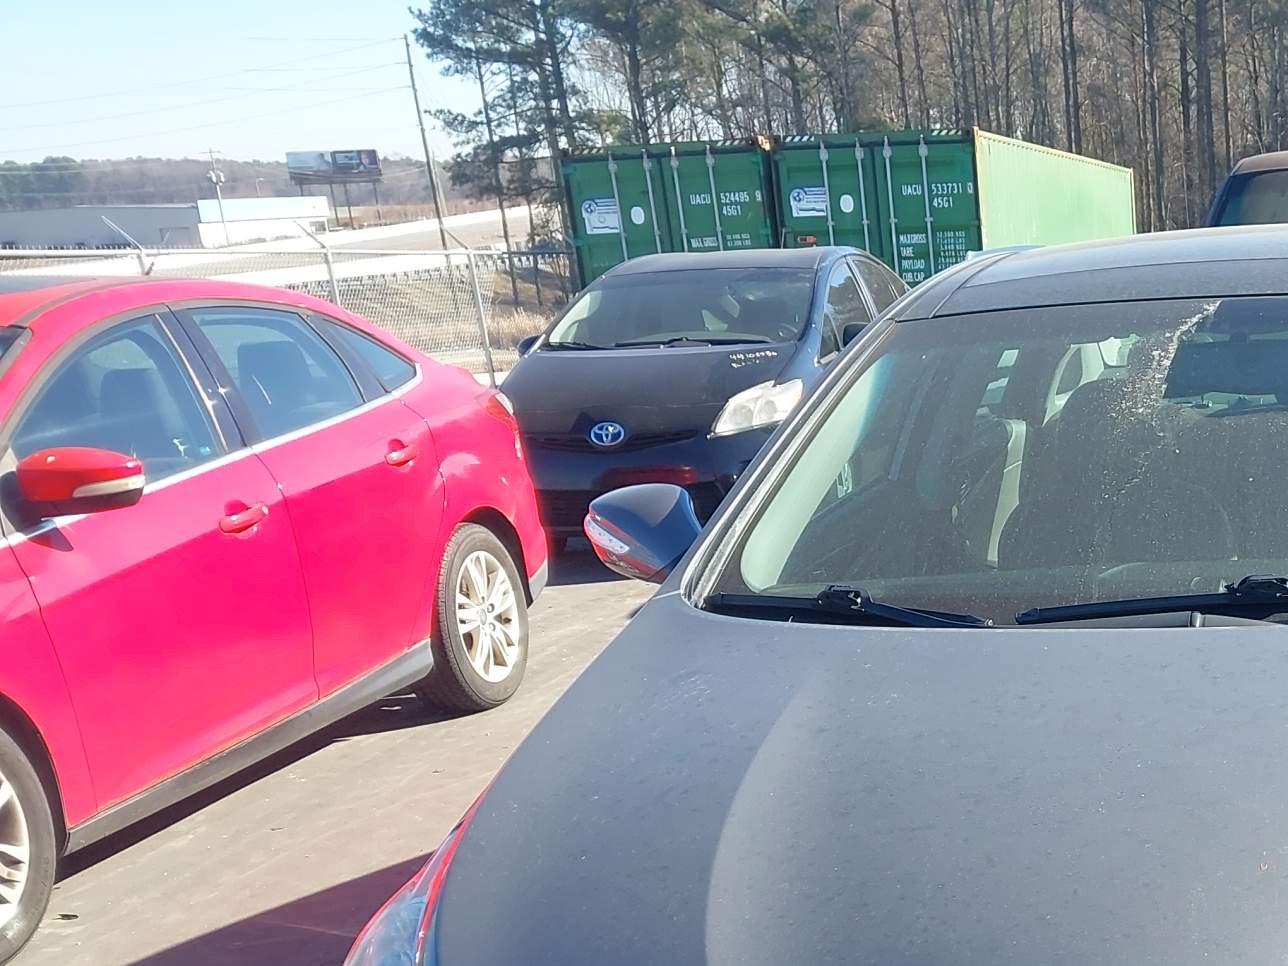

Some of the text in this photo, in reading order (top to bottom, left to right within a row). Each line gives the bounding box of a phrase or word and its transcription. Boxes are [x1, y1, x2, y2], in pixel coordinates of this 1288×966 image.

[902, 184, 922, 196] UACU
[931, 182, 963, 195] 533731
[689, 193, 712, 205] UACU
[932, 196, 953, 208] 45G1
[722, 205, 742, 217] 45G1
[901, 259, 926, 270] PAYLOAD
